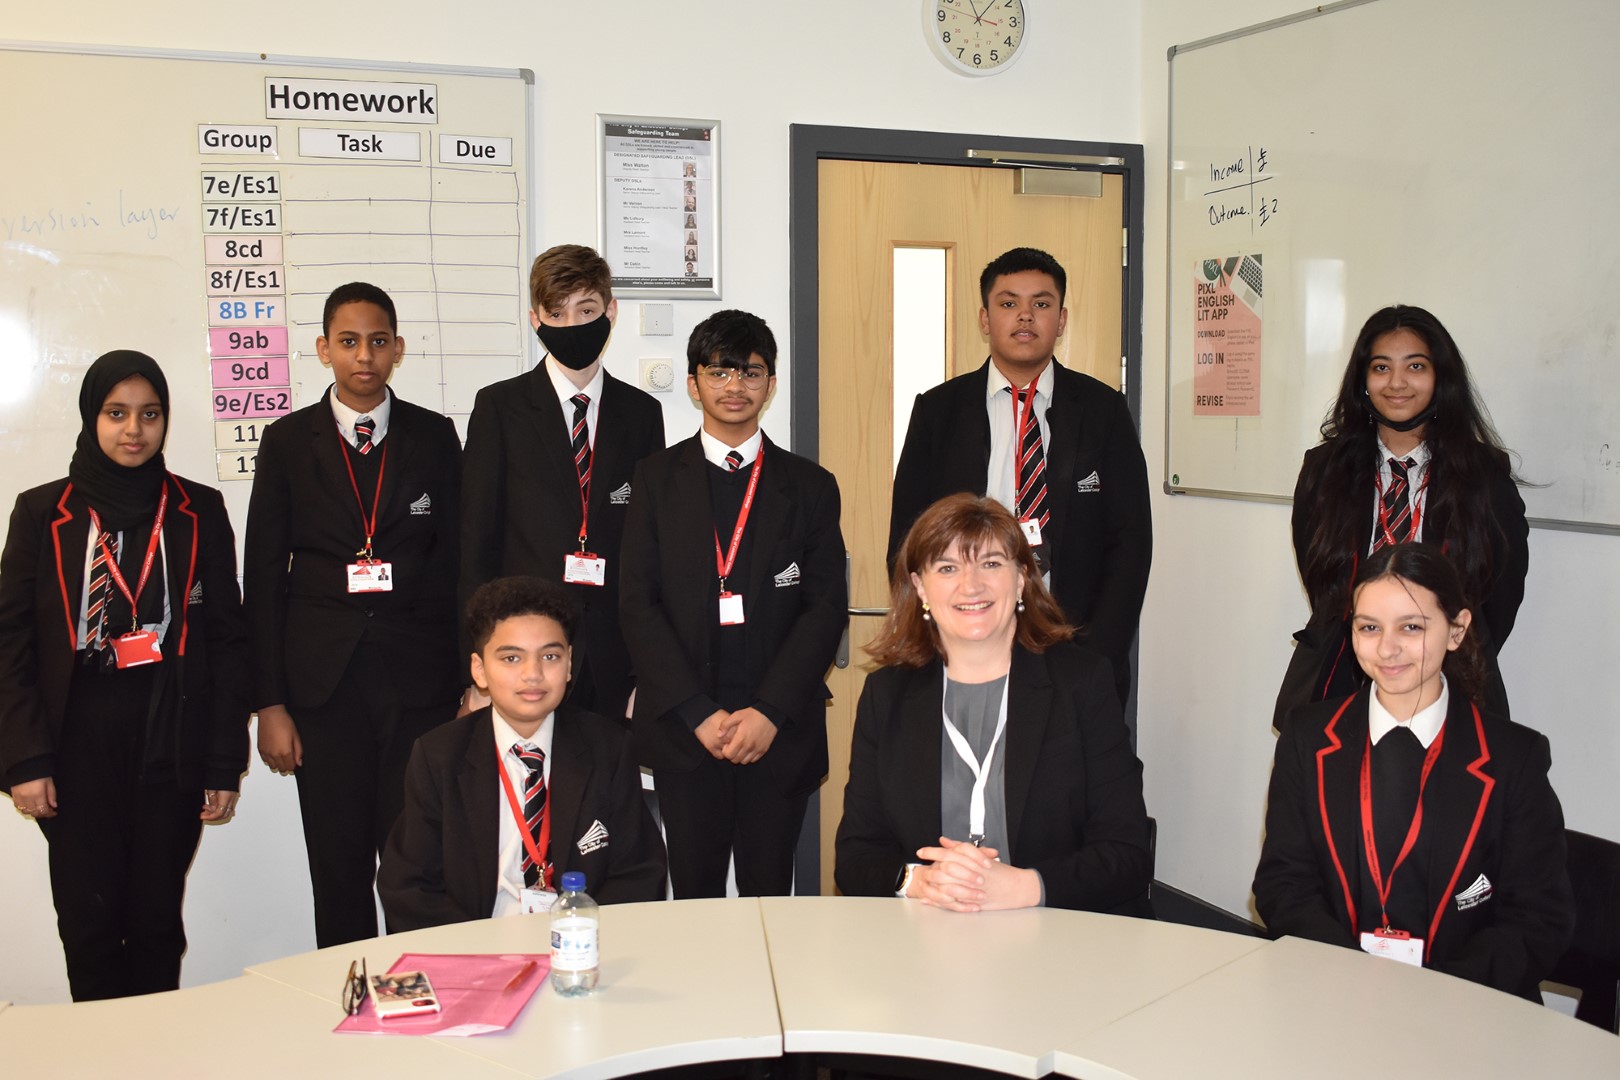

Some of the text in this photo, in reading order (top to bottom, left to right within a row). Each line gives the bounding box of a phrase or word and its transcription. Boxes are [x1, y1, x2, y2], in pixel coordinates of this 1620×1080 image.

[938, 10, 946, 22] 9
[1009, 17, 1017, 28] 3
[943, 32, 951, 43] 8
[1004, 36, 1012, 47] 4
[957, 48, 965, 59] 7
[973, 54, 981, 65] 6
[990, 50, 998, 61] 5
[269, 84, 435, 115] Homework
[628, 129, 664, 137] Safeguarding
[204, 129, 496, 158] Group Task Due
[1210, 159, 1244, 181] Income
[203, 174, 278, 198] 7e/Es1
[119, 189, 180, 240] layer
[207, 207, 277, 230] 7f/Es1
[225, 239, 263, 258] 8cd
[211, 270, 280, 292] 8f/Es1
[1198, 283, 1216, 295] PIXL
[1198, 295, 1235, 308] ENGLISH
[219, 301, 275, 319] 8B Fr
[1198, 309, 1228, 321] LIT APP
[228, 330, 269, 350] 9ab
[1198, 330, 1225, 338] DOWNLOAD
[1198, 352, 1224, 364] LOG IN
[231, 362, 269, 381] 9cd
[215, 392, 289, 414] 9e/Es2
[1197, 395, 1223, 407] REVISE
